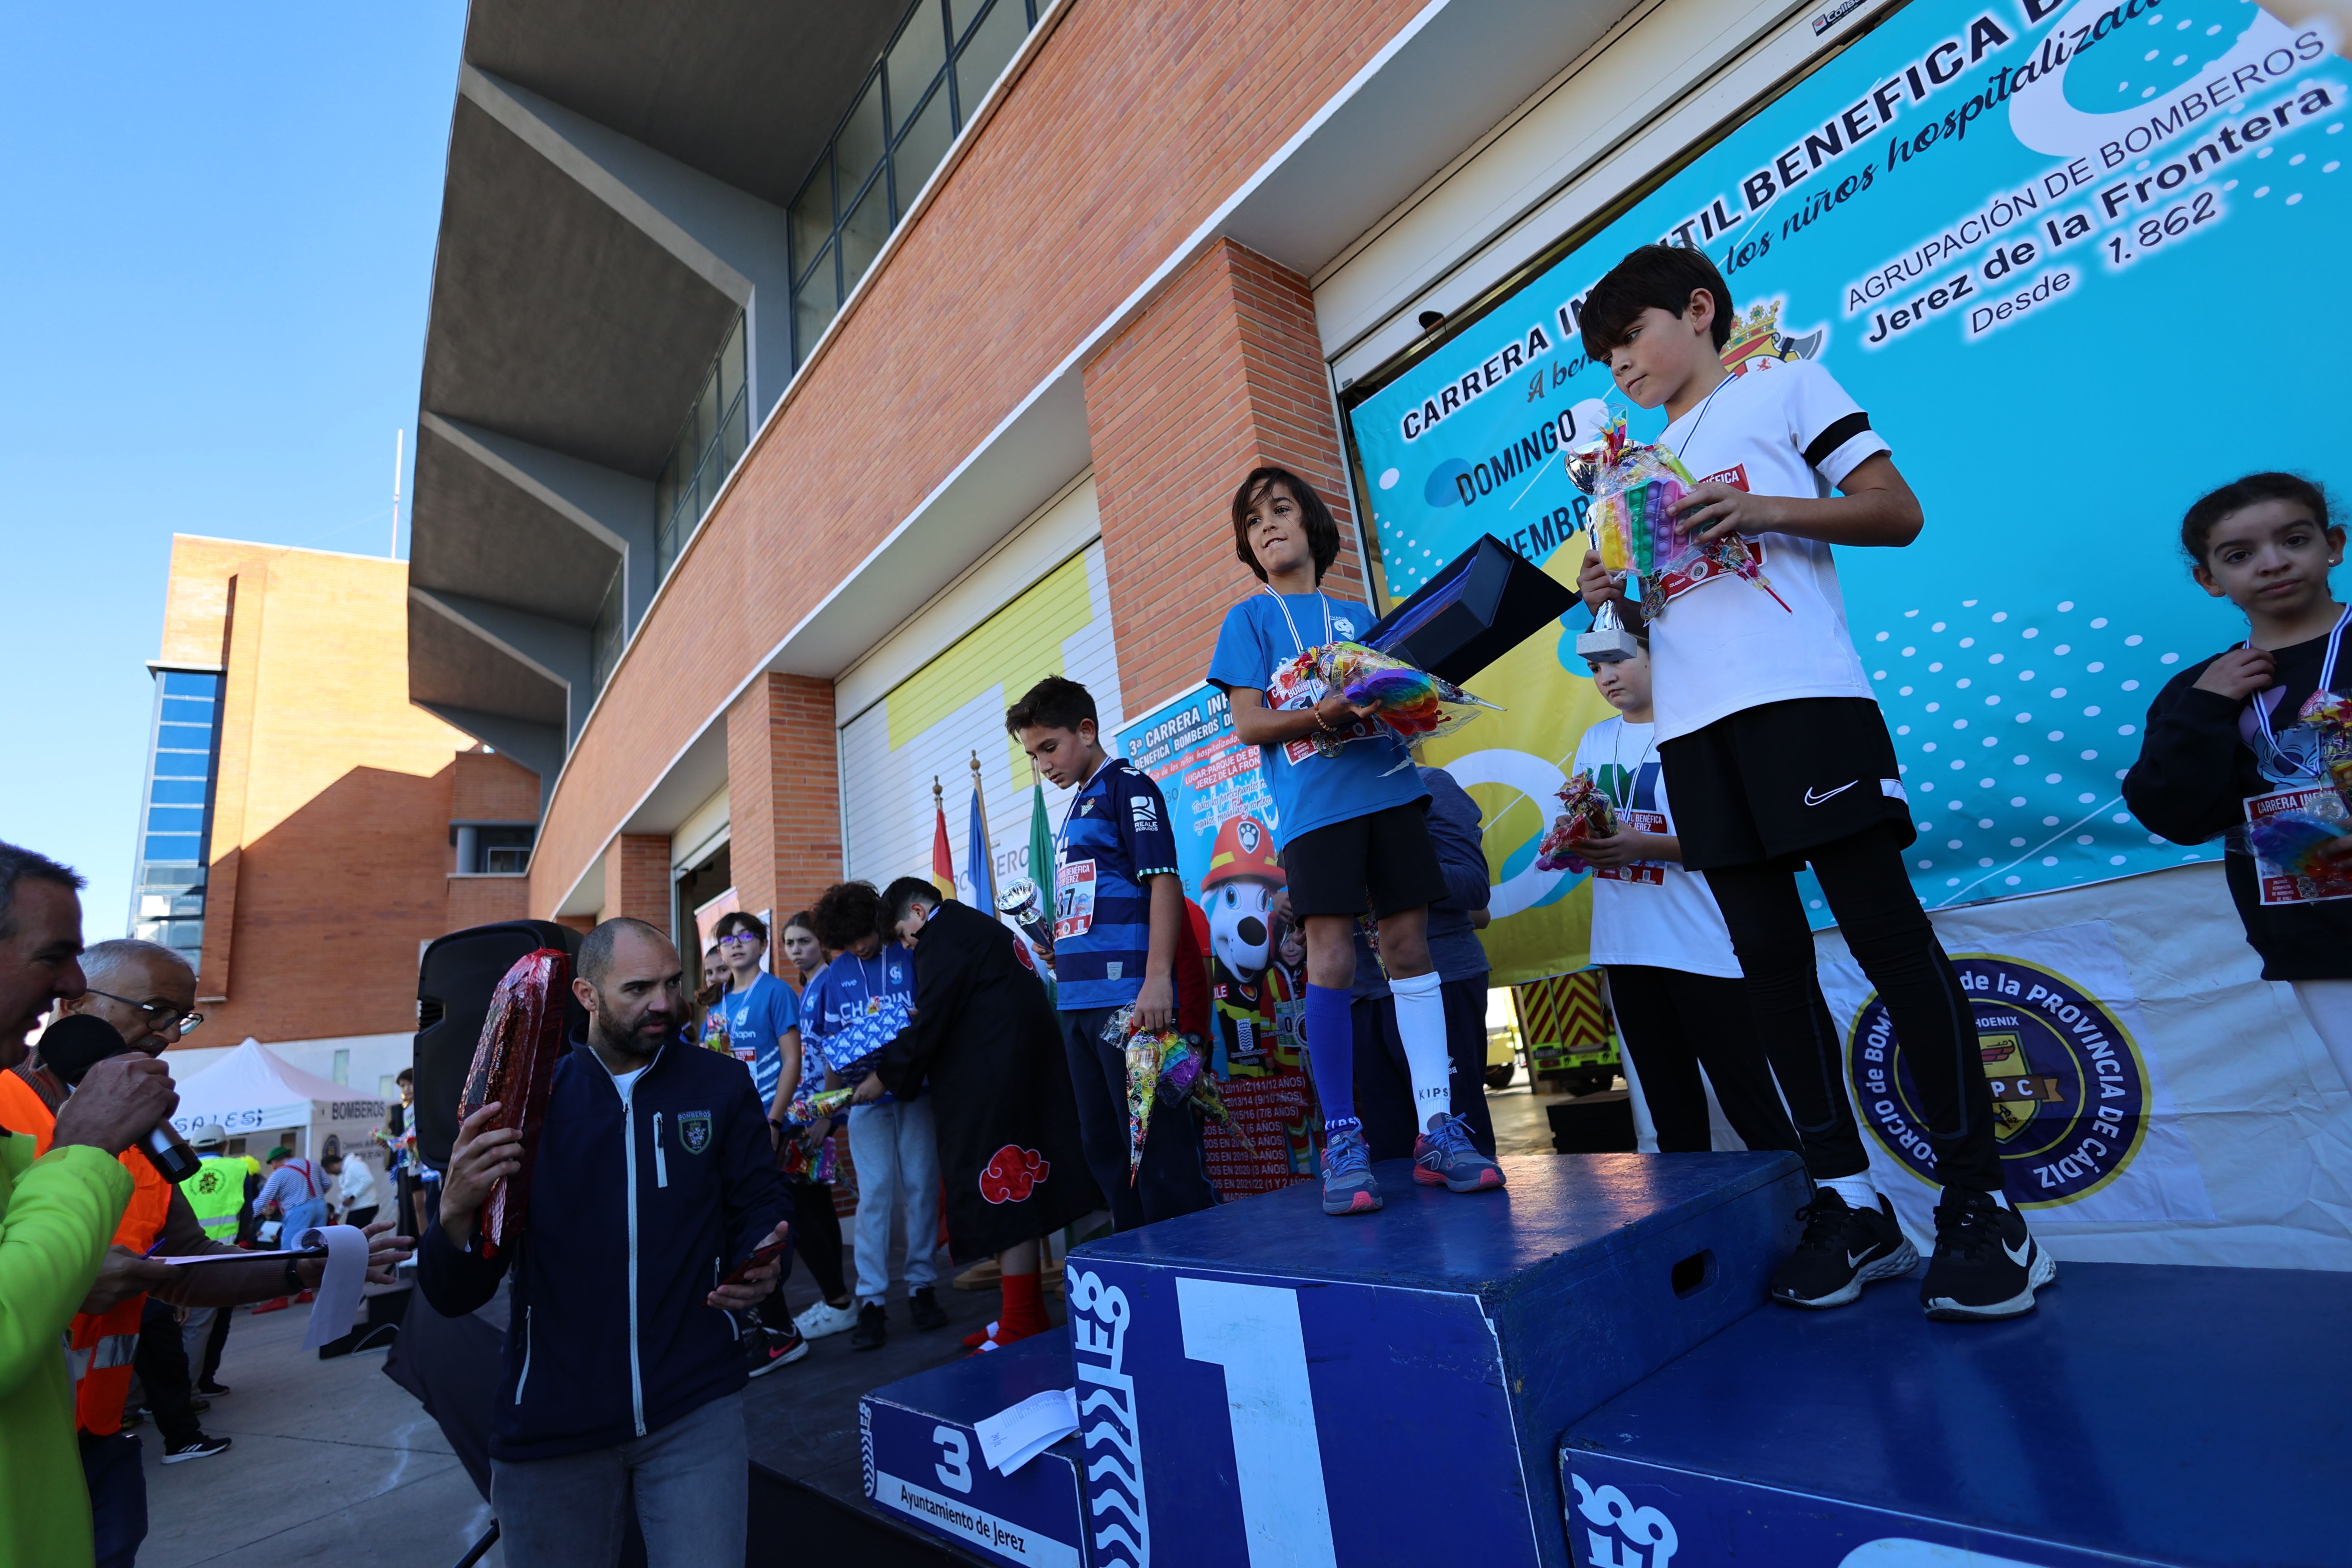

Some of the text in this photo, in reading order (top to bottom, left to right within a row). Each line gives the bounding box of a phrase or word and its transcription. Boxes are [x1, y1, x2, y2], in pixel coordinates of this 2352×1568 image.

[1849, 30, 2325, 311] AGRUPACIÓN DE BOMBEROS
[1527, 368, 1546, 404] A
[1727, 231, 1774, 275] los
[1782, 163, 1879, 241] niños
[1888, 0, 2158, 172] hospitaliza
[1868, 87, 2334, 343] Jerez de la Frontera
[1403, 16, 2009, 439] CARRERA INTIL BENEFICA
[1972, 272, 2072, 334] Desde
[1456, 409, 1577, 507] DOMINGO
[1289, 678, 1323, 699] BOMBERO
[1145, 707, 1201, 748] CARRERA
[1134, 744, 1170, 770] BENEFICA
[1173, 718, 1219, 751] BOMBEROS
[1162, 768, 1168, 776] de
[1170, 763, 1179, 774] los
[1181, 755, 1194, 768] niños
[1236, 752, 1247, 763] DE
[1195, 756, 1261, 790] JEREZ DE LA FRON
[1193, 797, 1210, 813] Todos
[1219, 781, 1259, 809] participantes
[2257, 796, 2298, 815] CARRERA
[1194, 796, 1272, 834] regalos, medallas y sorteos
[1635, 813, 1663, 825] BENÉFICA
[1066, 864, 1090, 876] BENÉFICA
[1066, 874, 1079, 885] JEREZ
[841, 979, 857, 988] vive
[839, 990, 912, 1020] CHPIN
[1975, 1016, 2020, 1028] HOENIX
[1260, 1029, 1285, 1038] COLABORAN
[1225, 1082, 1252, 1094] 2011/12
[1278, 1075, 1306, 1090] AÑOS)
[1865, 1067, 1887, 1094] de
[1960, 970, 2126, 1189] de la PROVINCIA DE CÁDIZ
[1990, 1079, 2034, 1098] P C
[1255, 1094, 1275, 1108] (9/10
[1277, 1090, 1303, 1103] AÑOS)
[1419, 1087, 1450, 1101] KIPS
[331, 1101, 386, 1120] BOMBEROS
[677, 1111, 711, 1121] BOMBEROS
[1257, 1107, 1272, 1121] (7/8
[1274, 1105, 1299, 1118] AÑOS)
[1246, 1122, 1254, 1136] (6
[1256, 1120, 1283, 1133] AÑOS)
[1324, 1117, 1357, 1131] KIPS
[1220, 1139, 1231, 1148] EN
[1257, 1134, 1286, 1148] AÑOS)
[1874, 1099, 1939, 1169] ORCIO
[1221, 1152, 1232, 1162] EN
[1259, 1148, 1287, 1162] AÑOS)
[1222, 1165, 1234, 1175] EN
[1234, 1165, 1251, 1175] 2020
[1252, 1164, 1260, 1177] (3
[1261, 1163, 1289, 1176] AÑOS)
[1225, 1179, 1235, 1189] EN
[1274, 1179, 1280, 1189] Y
[1175, 1276, 1338, 1568] 1
[933, 1425, 972, 1494] 3
[901, 1485, 1026, 1553] Ayuntamiento de Jerez
